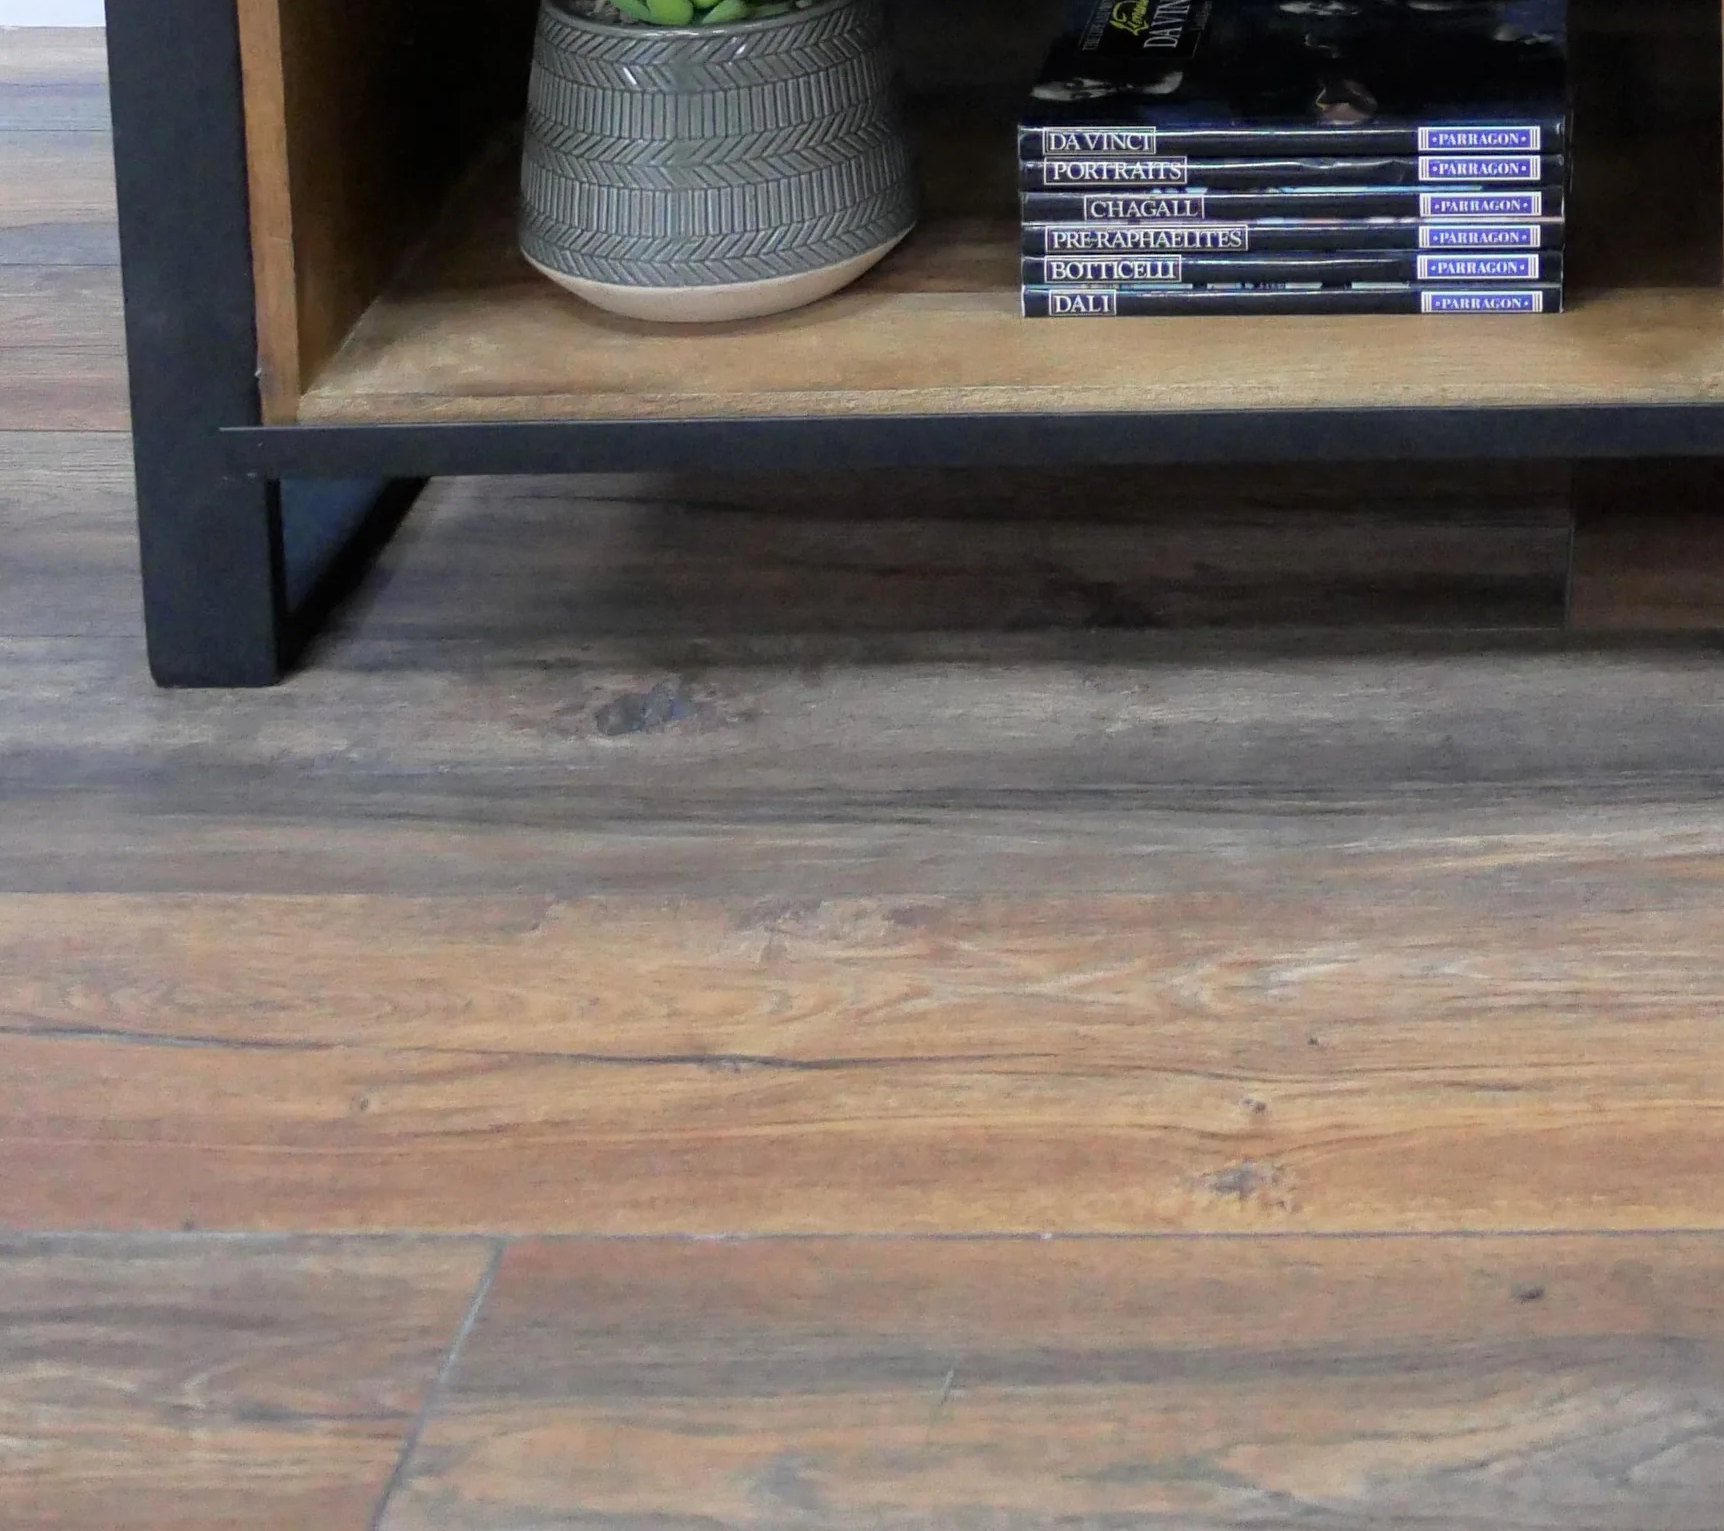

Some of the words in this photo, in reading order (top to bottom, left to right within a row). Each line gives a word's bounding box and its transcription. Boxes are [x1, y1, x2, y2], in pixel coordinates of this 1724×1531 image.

[1084, 132, 1150, 151] VINCI
[1438, 133, 1520, 145] PARRAGON
[1053, 161, 1182, 181] PORTRAITS
[1438, 162, 1520, 175] PARRAGON
[1090, 199, 1199, 218] CHAGALL
[1440, 199, 1521, 212] PARRAGON
[1052, 229, 1243, 249] PRE-RAPHAELITES
[1439, 232, 1520, 244] PARRAGON
[1050, 260, 1177, 280] BOTTICELLI
[1437, 261, 1518, 274] PARRAGON
[1054, 294, 1110, 314] DALI
[1441, 297, 1522, 309] PARRAGON
